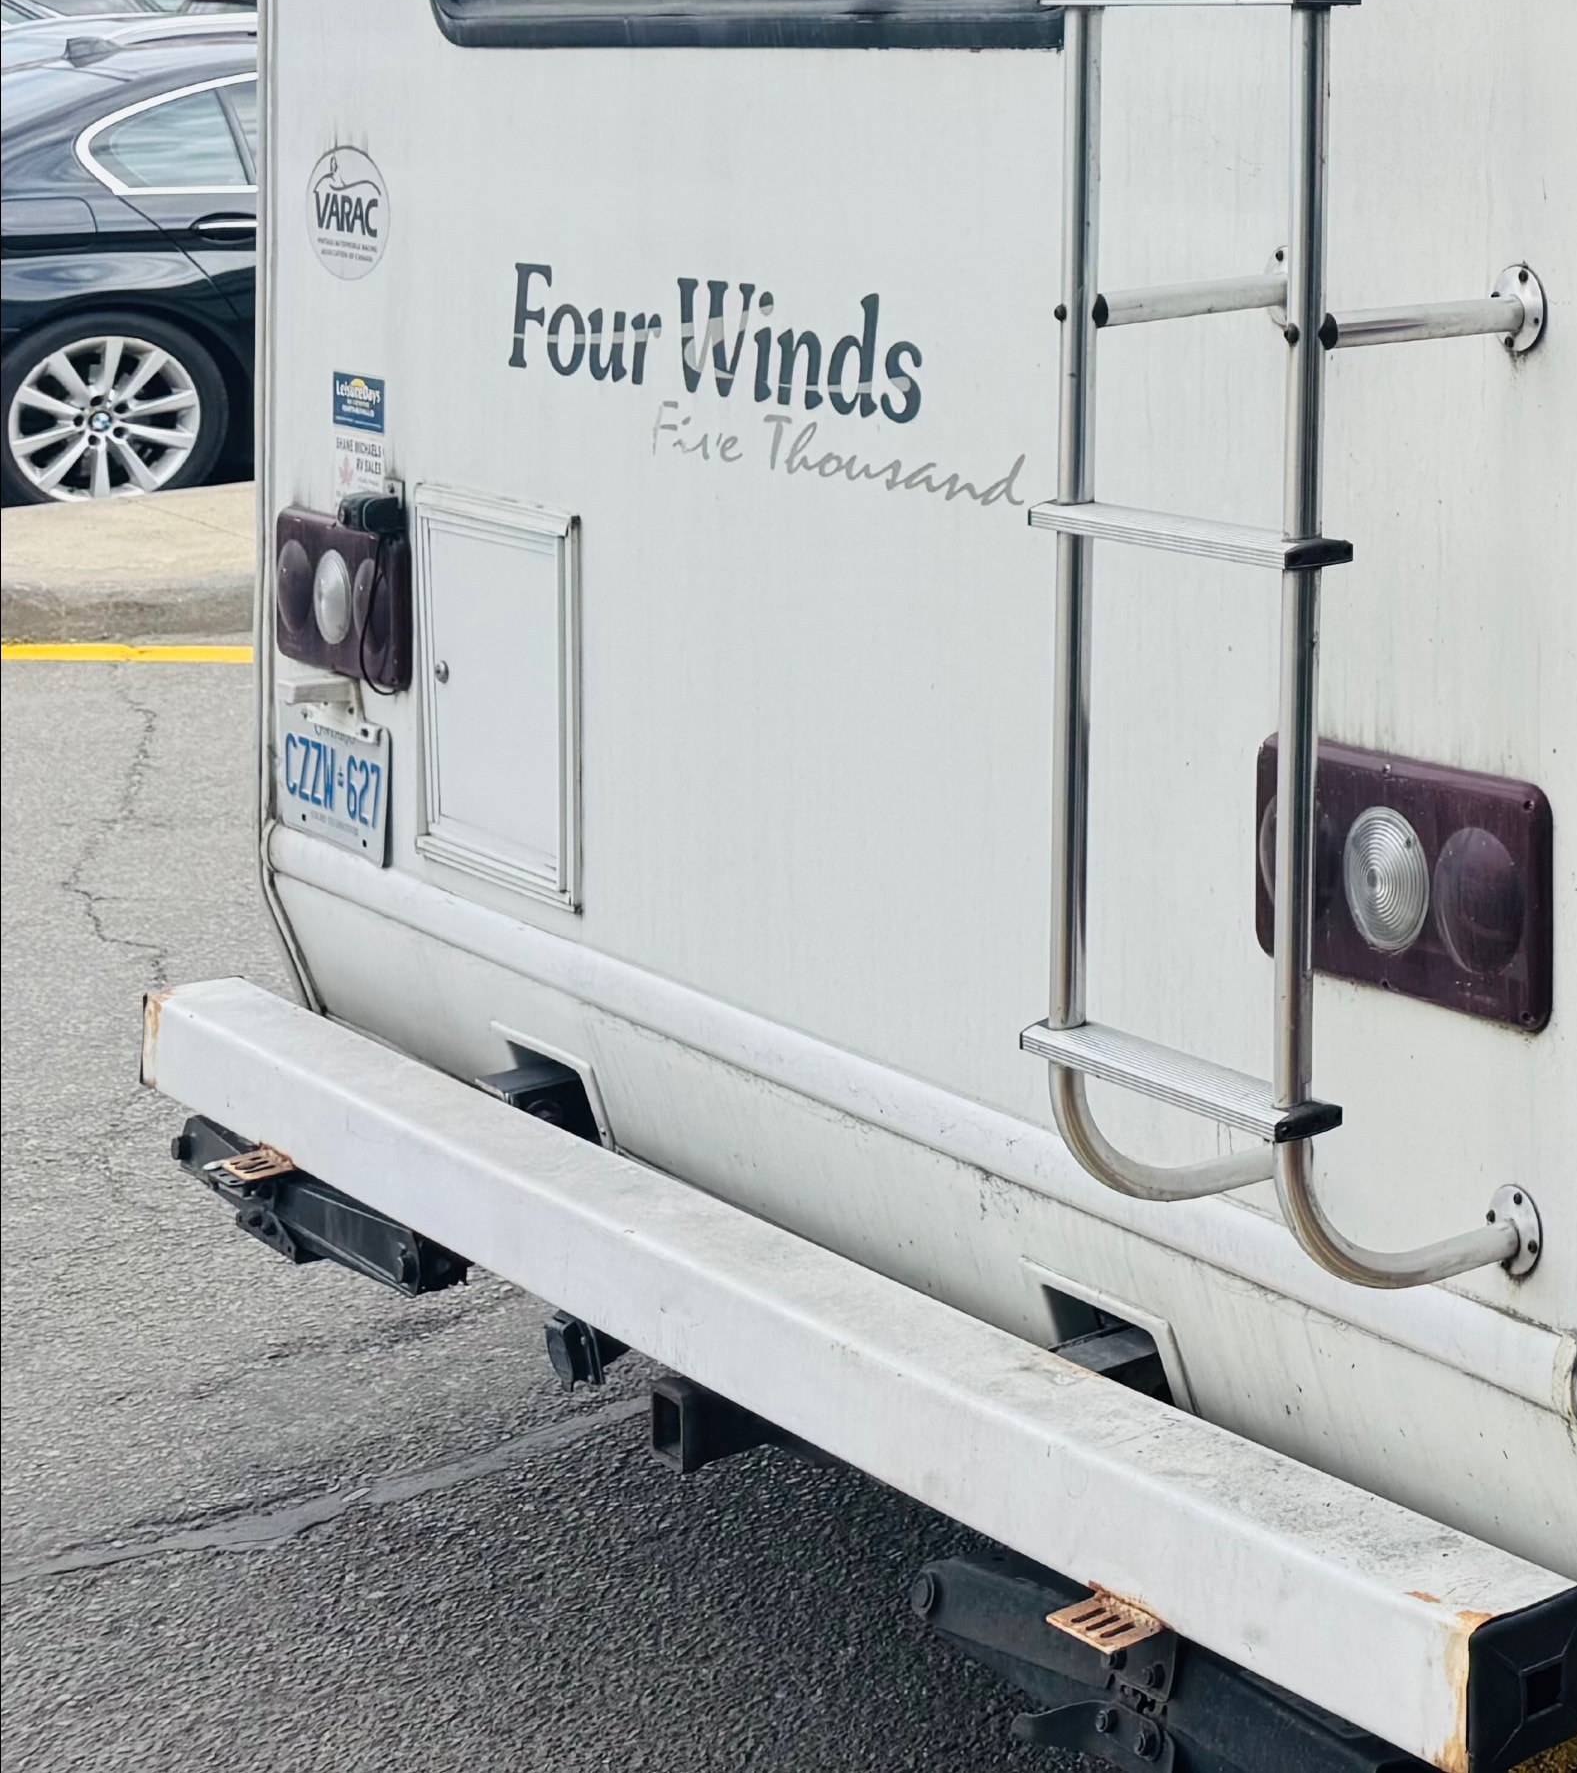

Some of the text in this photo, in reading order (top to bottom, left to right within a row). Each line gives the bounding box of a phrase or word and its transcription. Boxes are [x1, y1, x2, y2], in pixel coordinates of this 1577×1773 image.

[313, 191, 379, 238] VARAC
[508, 263, 923, 423] Four Winds
[763, 414, 1026, 506] Thousand
